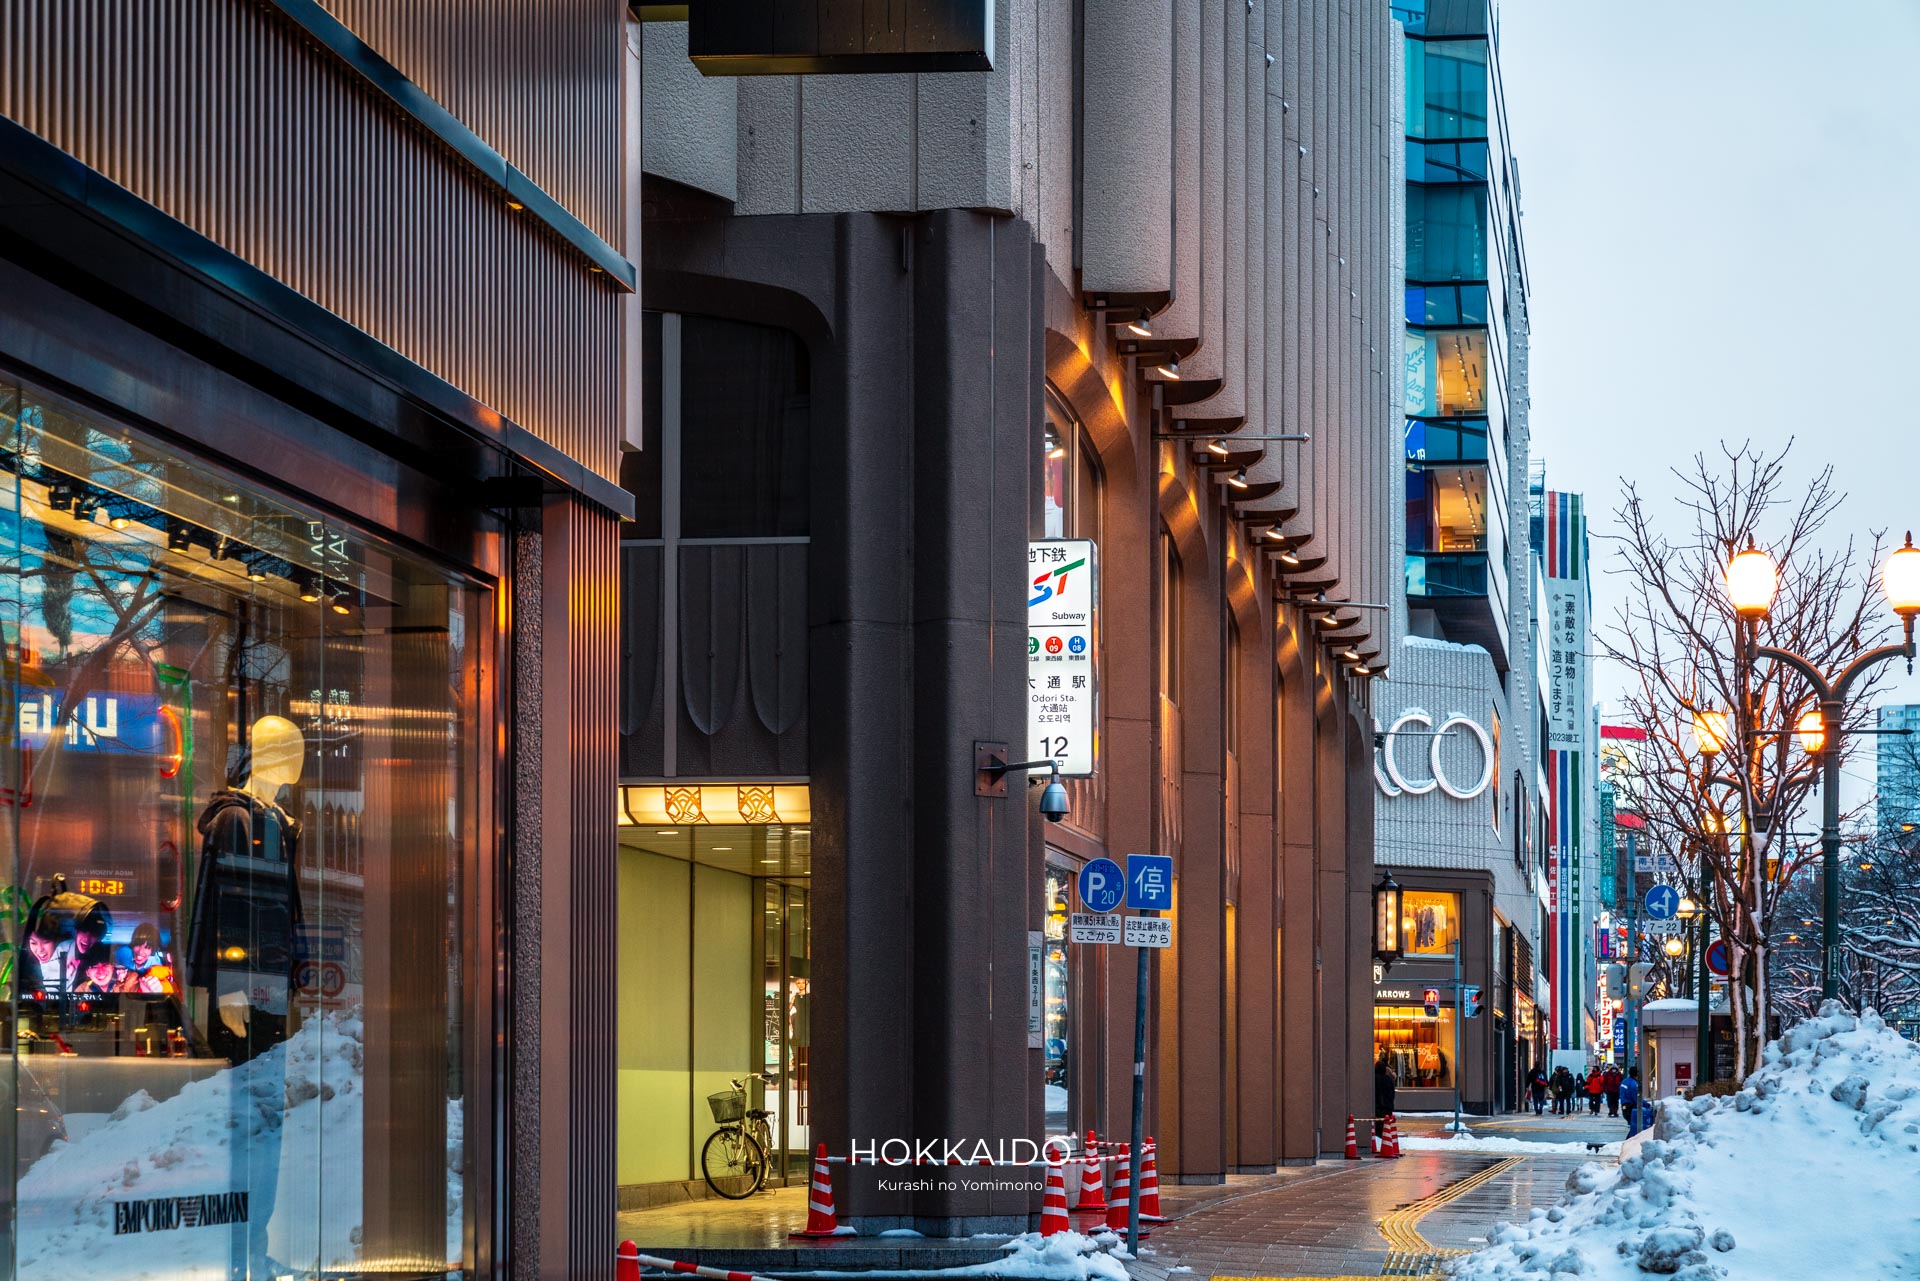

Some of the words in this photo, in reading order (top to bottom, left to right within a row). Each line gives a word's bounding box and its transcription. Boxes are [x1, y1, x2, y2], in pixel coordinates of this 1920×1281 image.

[1052, 611, 1086, 621] Subway
[1072, 644, 1082, 652] 08
[1031, 694, 1058, 703] Odori
[1060, 694, 1077, 702] Sta.
[1040, 703, 1068, 713] 大通站
[1038, 714, 1071, 723] 오도리역
[1040, 736, 1069, 758] 12
[1134, 865, 1165, 899] 停
[1087, 872, 1106, 904] P
[1101, 889, 1115, 905] 20
[1076, 931, 1116, 942] ここから
[1126, 932, 1169, 945] ここから
[1376, 990, 1411, 999] ARROWS
[114, 1198, 181, 1235] EMPORIO
